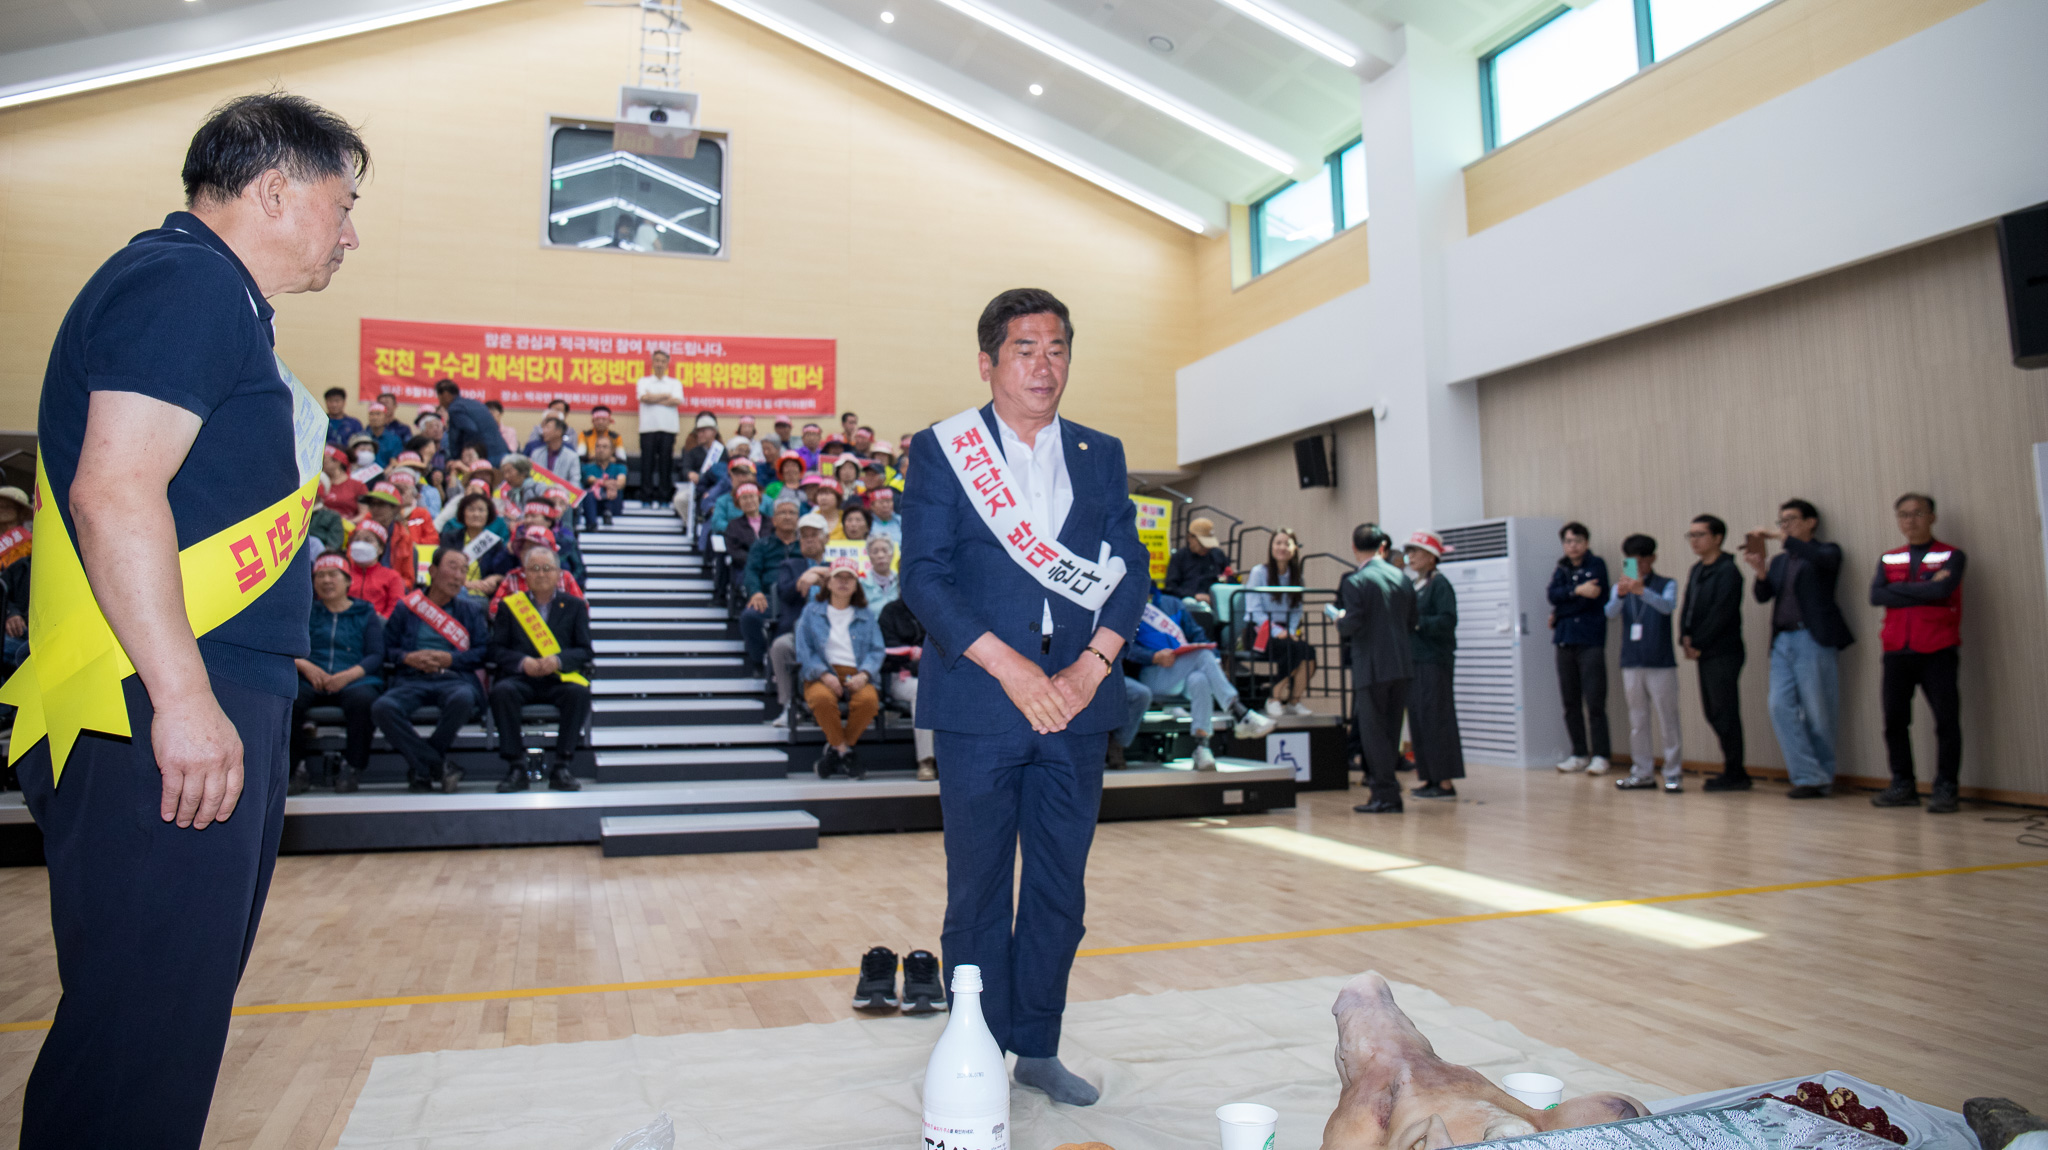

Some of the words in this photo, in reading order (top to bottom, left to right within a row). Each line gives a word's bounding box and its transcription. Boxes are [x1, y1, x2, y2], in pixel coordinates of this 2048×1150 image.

[485, 332, 513, 349] 많은
[516, 334, 557, 351] 관심과
[560, 335, 613, 353] 적극적인
[616, 337, 643, 354] 참여
[375, 348, 415, 377] 진천
[421, 351, 481, 380] 구수리
[486, 354, 564, 383] 채석단지
[569, 357, 645, 387] 지정반대
[675, 361, 766, 390] 대책위원회
[770, 364, 824, 391] 발대식
[951, 427, 1017, 518] 채석단지
